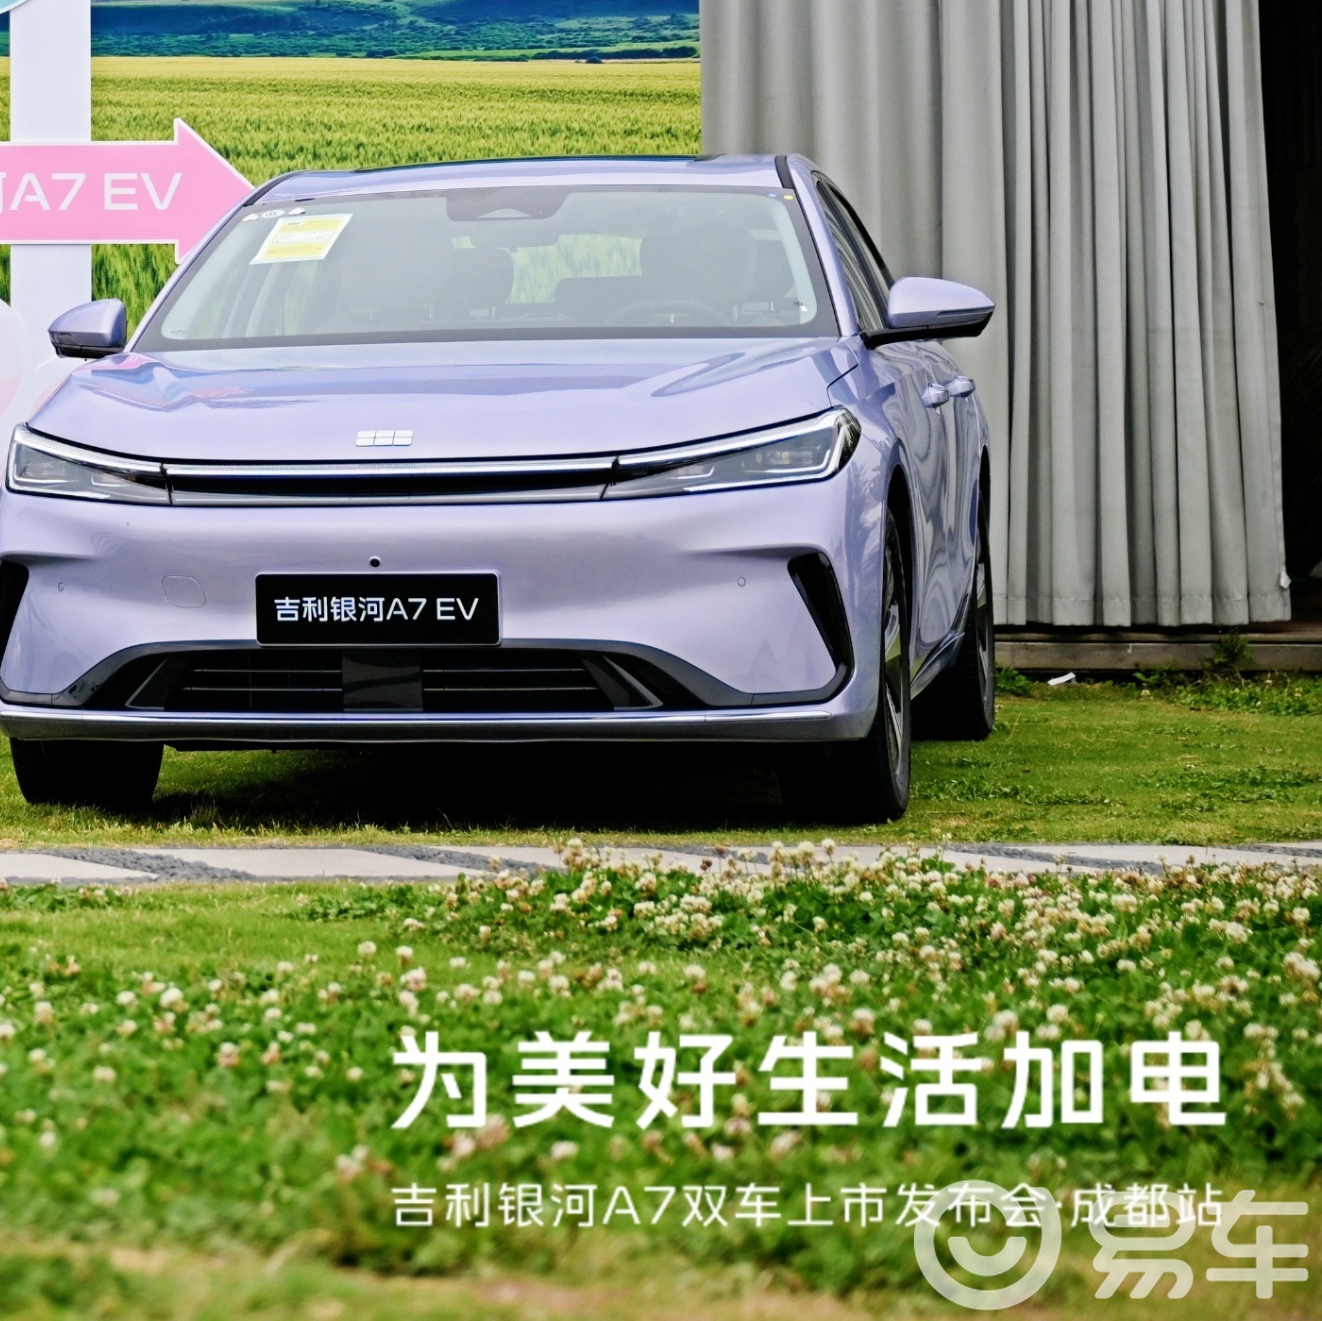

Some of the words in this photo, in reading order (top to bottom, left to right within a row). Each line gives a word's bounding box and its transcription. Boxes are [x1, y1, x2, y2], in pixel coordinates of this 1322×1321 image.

[103, 171, 183, 211] EV
[274, 596, 427, 622] 吉利银河A7
[436, 597, 480, 621] EV
